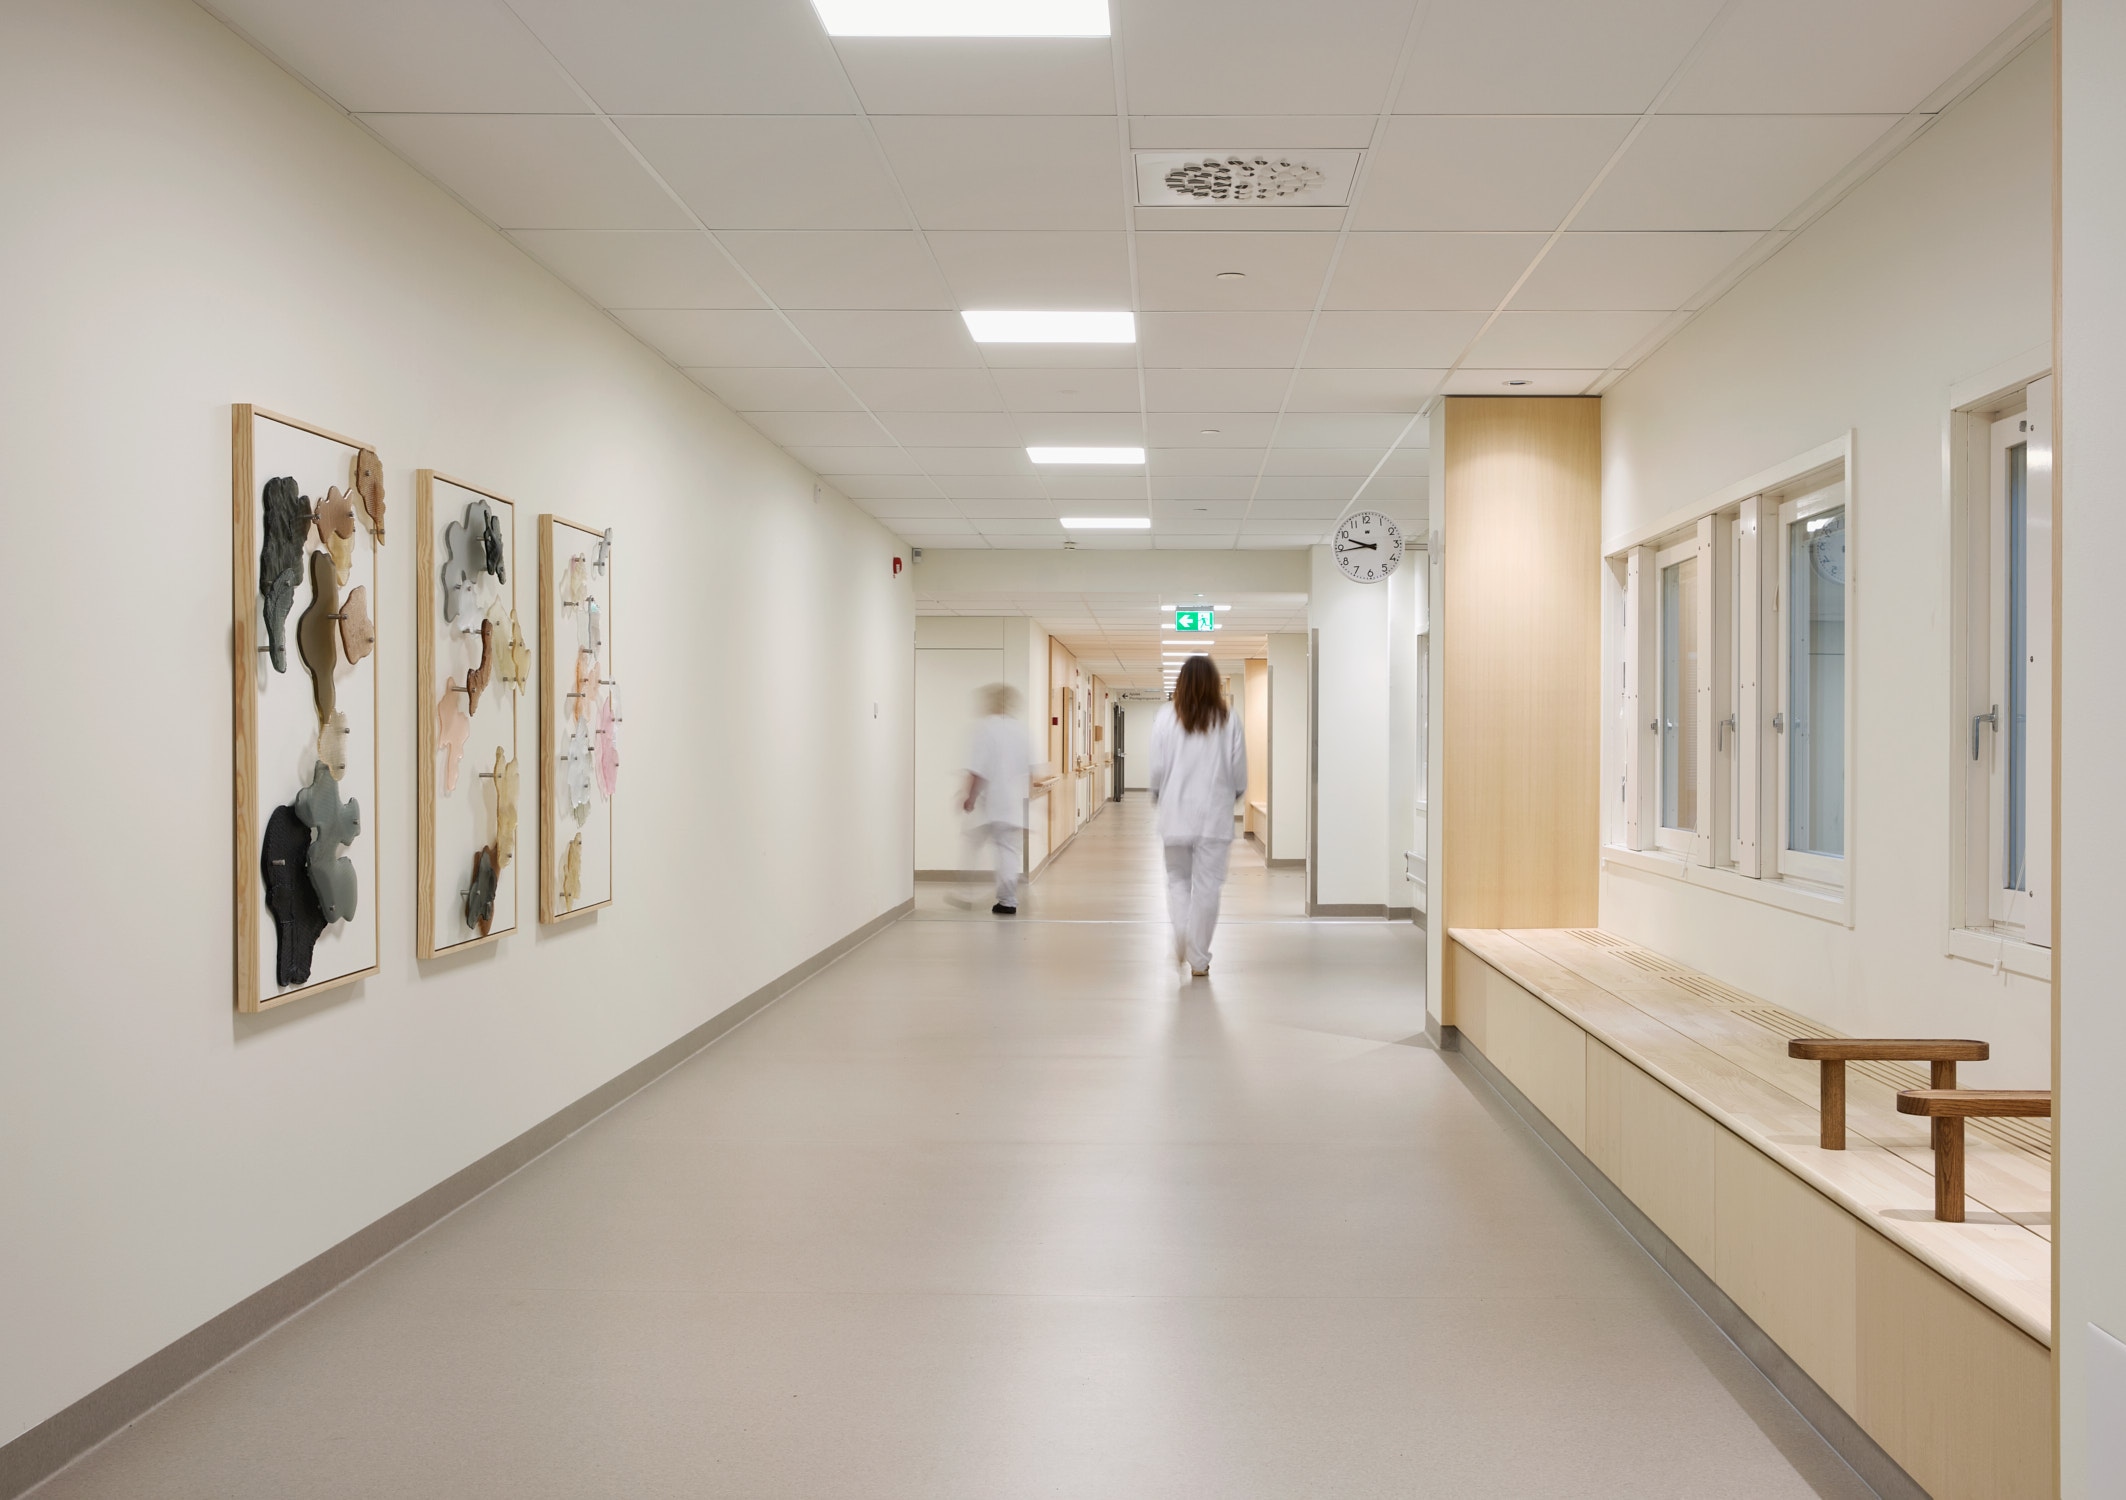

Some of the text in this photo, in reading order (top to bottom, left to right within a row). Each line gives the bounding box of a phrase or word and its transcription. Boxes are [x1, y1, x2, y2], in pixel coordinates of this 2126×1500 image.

[1350, 520, 1358, 528] 11
[1362, 516, 1370, 524] 12
[1341, 530, 1348, 539] 10
[1388, 527, 1395, 536] 2
[1338, 544, 1344, 552] 9
[1393, 540, 1399, 548] 3
[1343, 557, 1349, 566] 8
[1389, 554, 1396, 562] 4
[1354, 566, 1360, 574] 7
[1382, 564, 1388, 572] 5
[1368, 569, 1374, 577] 6
